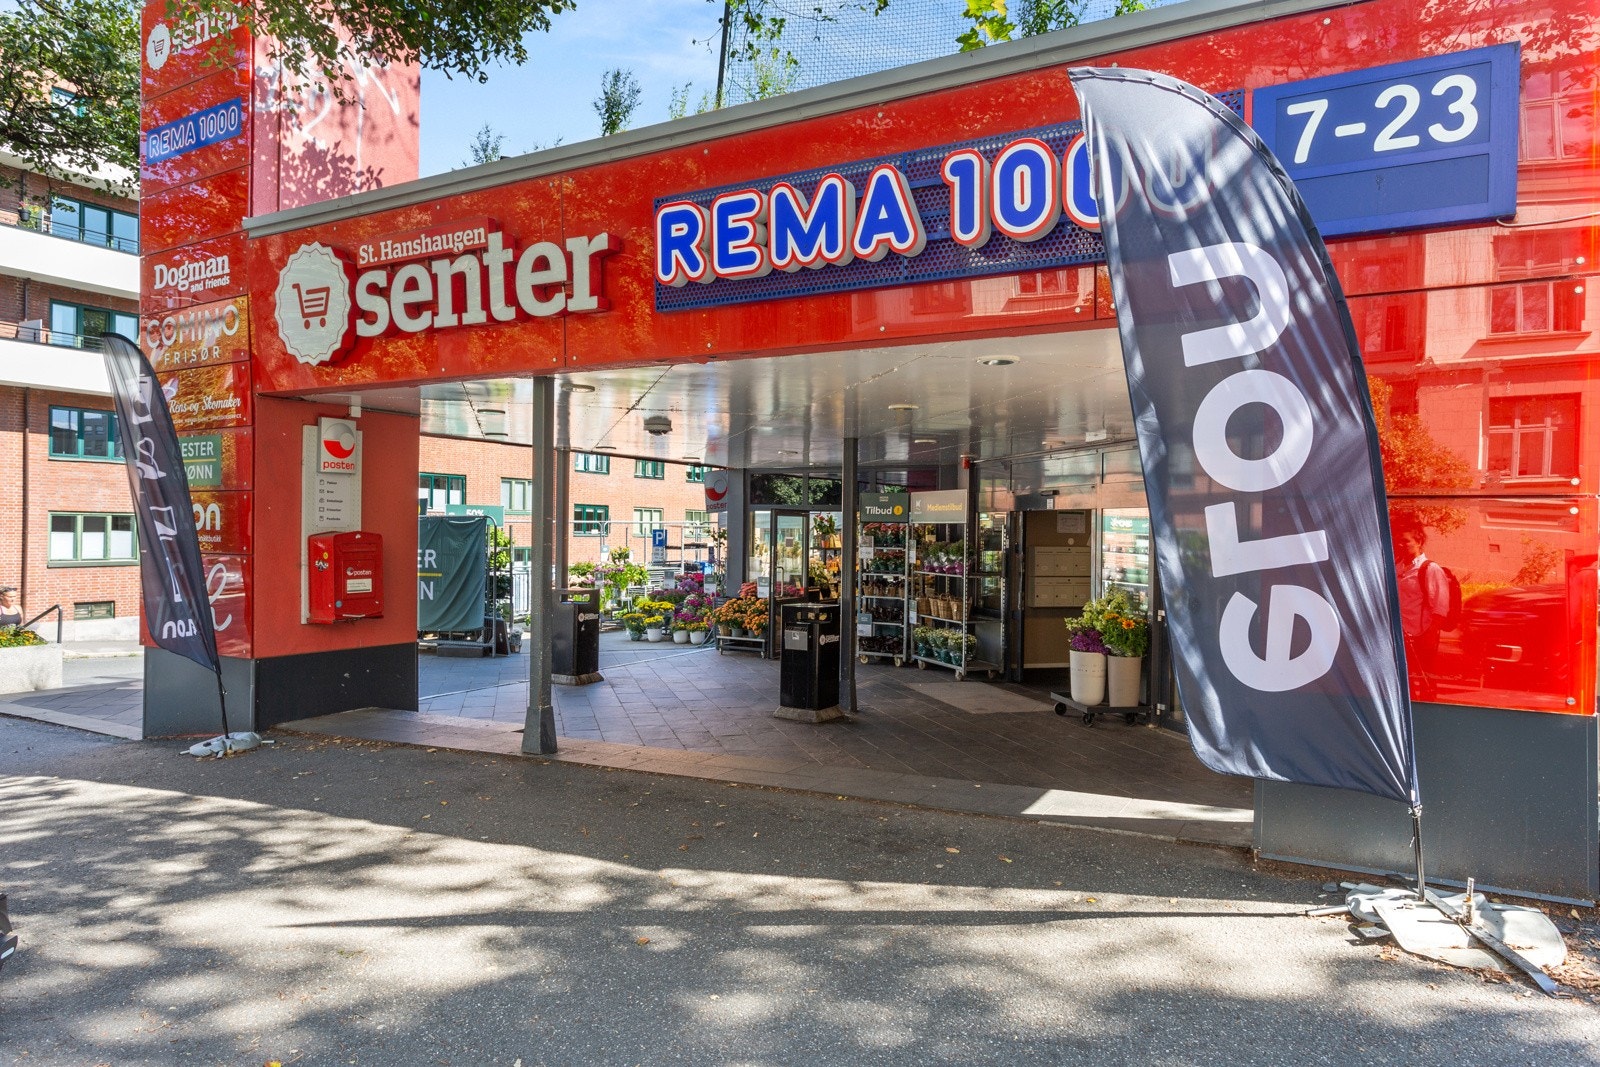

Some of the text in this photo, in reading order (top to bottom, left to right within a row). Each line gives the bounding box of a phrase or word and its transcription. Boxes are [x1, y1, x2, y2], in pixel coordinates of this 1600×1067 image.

[1286, 74, 1479, 164] 7-23
[150, 106, 238, 158] REMA 1000
[655, 164, 922, 288] REMA
[358, 227, 487, 265] St. Hanshaugen
[154, 255, 230, 291] Dogman
[355, 230, 609, 337] senter
[190, 275, 230, 293] and friends
[146, 305, 239, 349] COMINO
[164, 345, 220, 365] FRISØR
[189, 402, 199, 415] og
[202, 393, 242, 410] Skomaker
[179, 441, 214, 457] ESTER
[185, 464, 213, 480] ØNN
[323, 461, 355, 470] posten
[865, 505, 893, 515] Tilbud
[655, 531, 664, 545] P
[353, 568, 372, 576] posten
